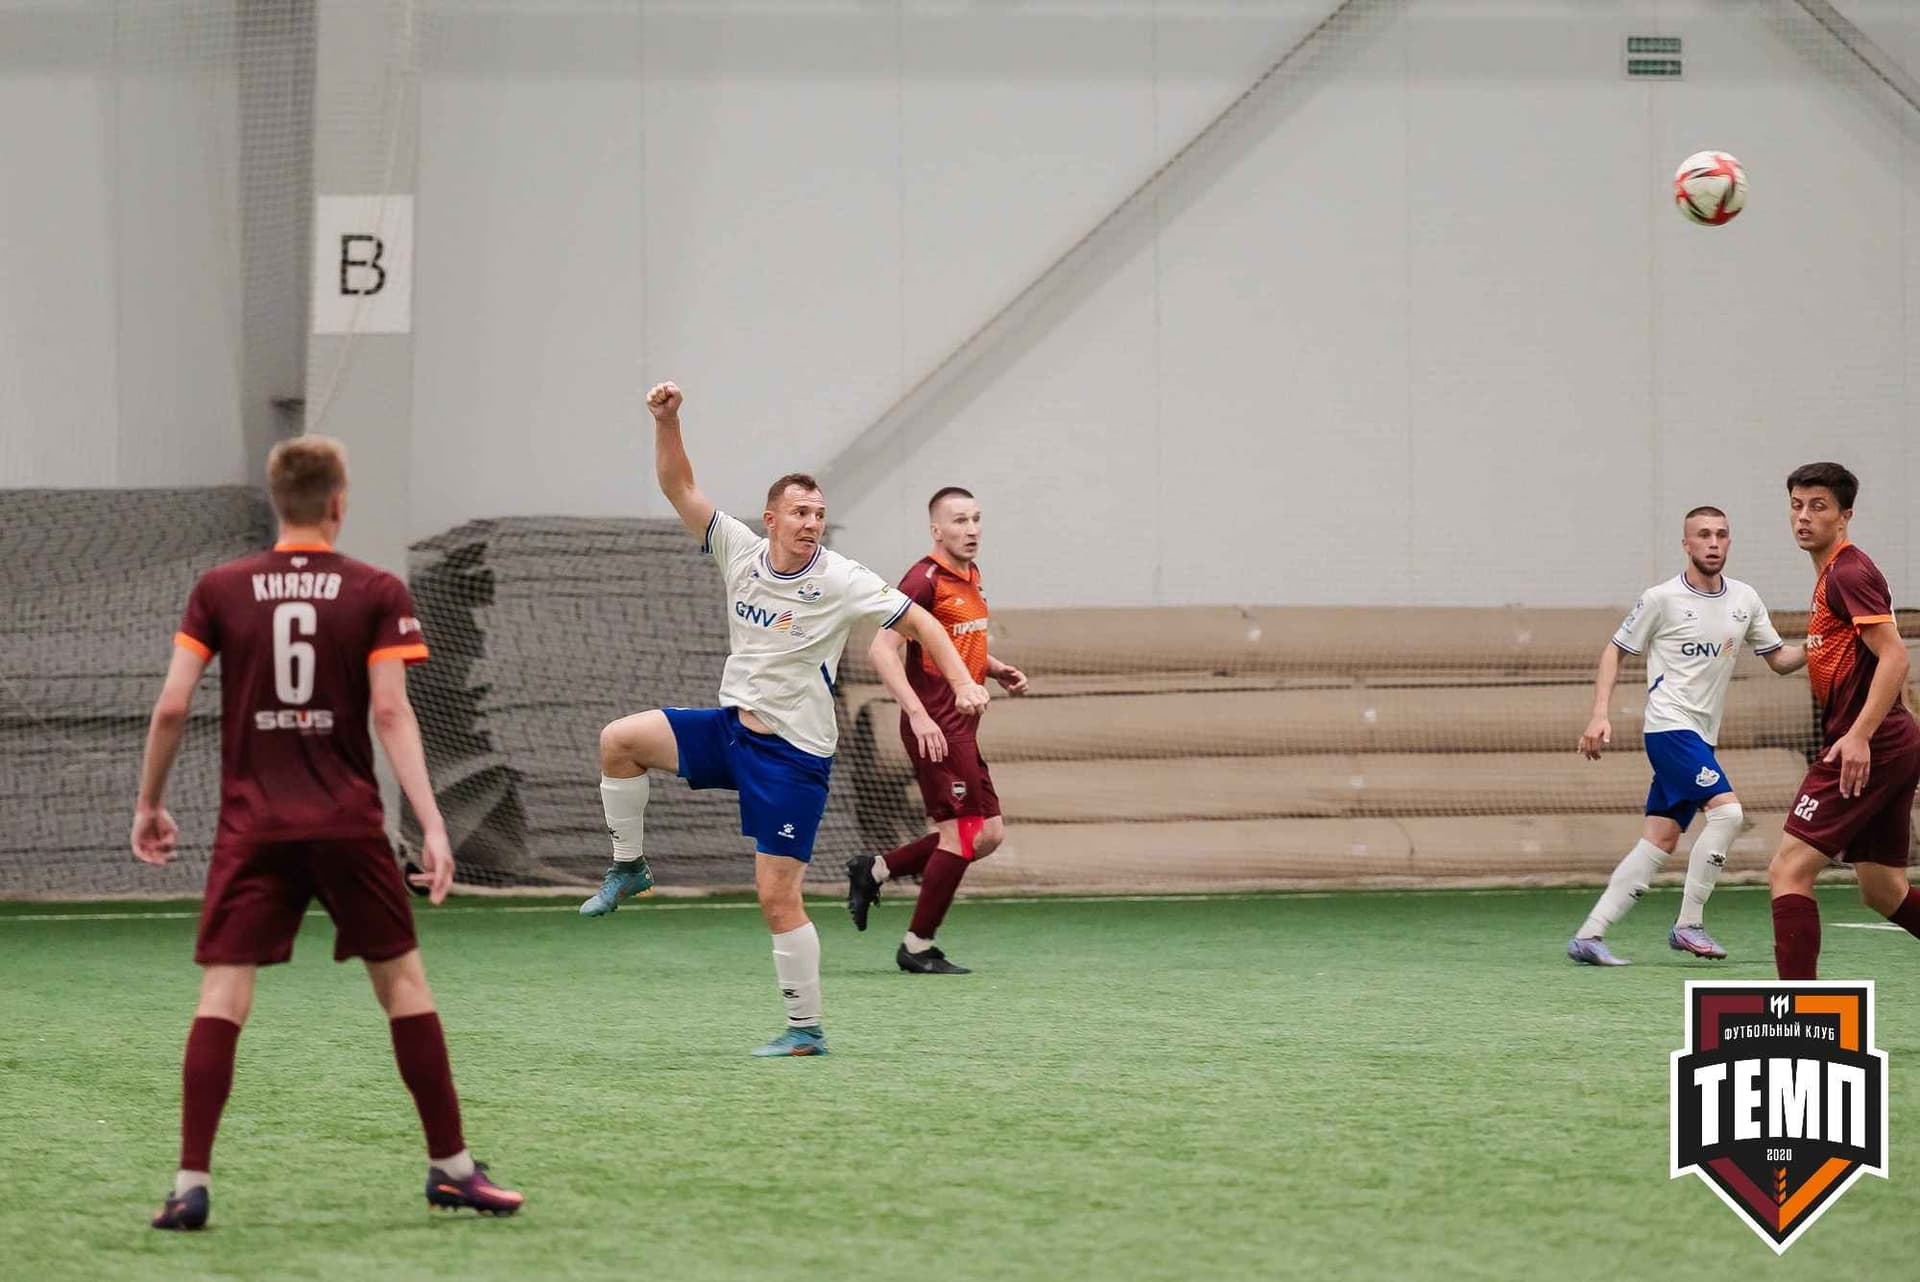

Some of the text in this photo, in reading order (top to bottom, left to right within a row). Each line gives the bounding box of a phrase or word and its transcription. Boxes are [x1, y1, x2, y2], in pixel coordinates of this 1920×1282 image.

[252, 572, 342, 602] КНЯЗЕВ
[736, 601, 777, 627] GNV
[273, 601, 317, 705] 6
[1681, 642, 1722, 658] GNV
[1795, 794, 1819, 821] 22
